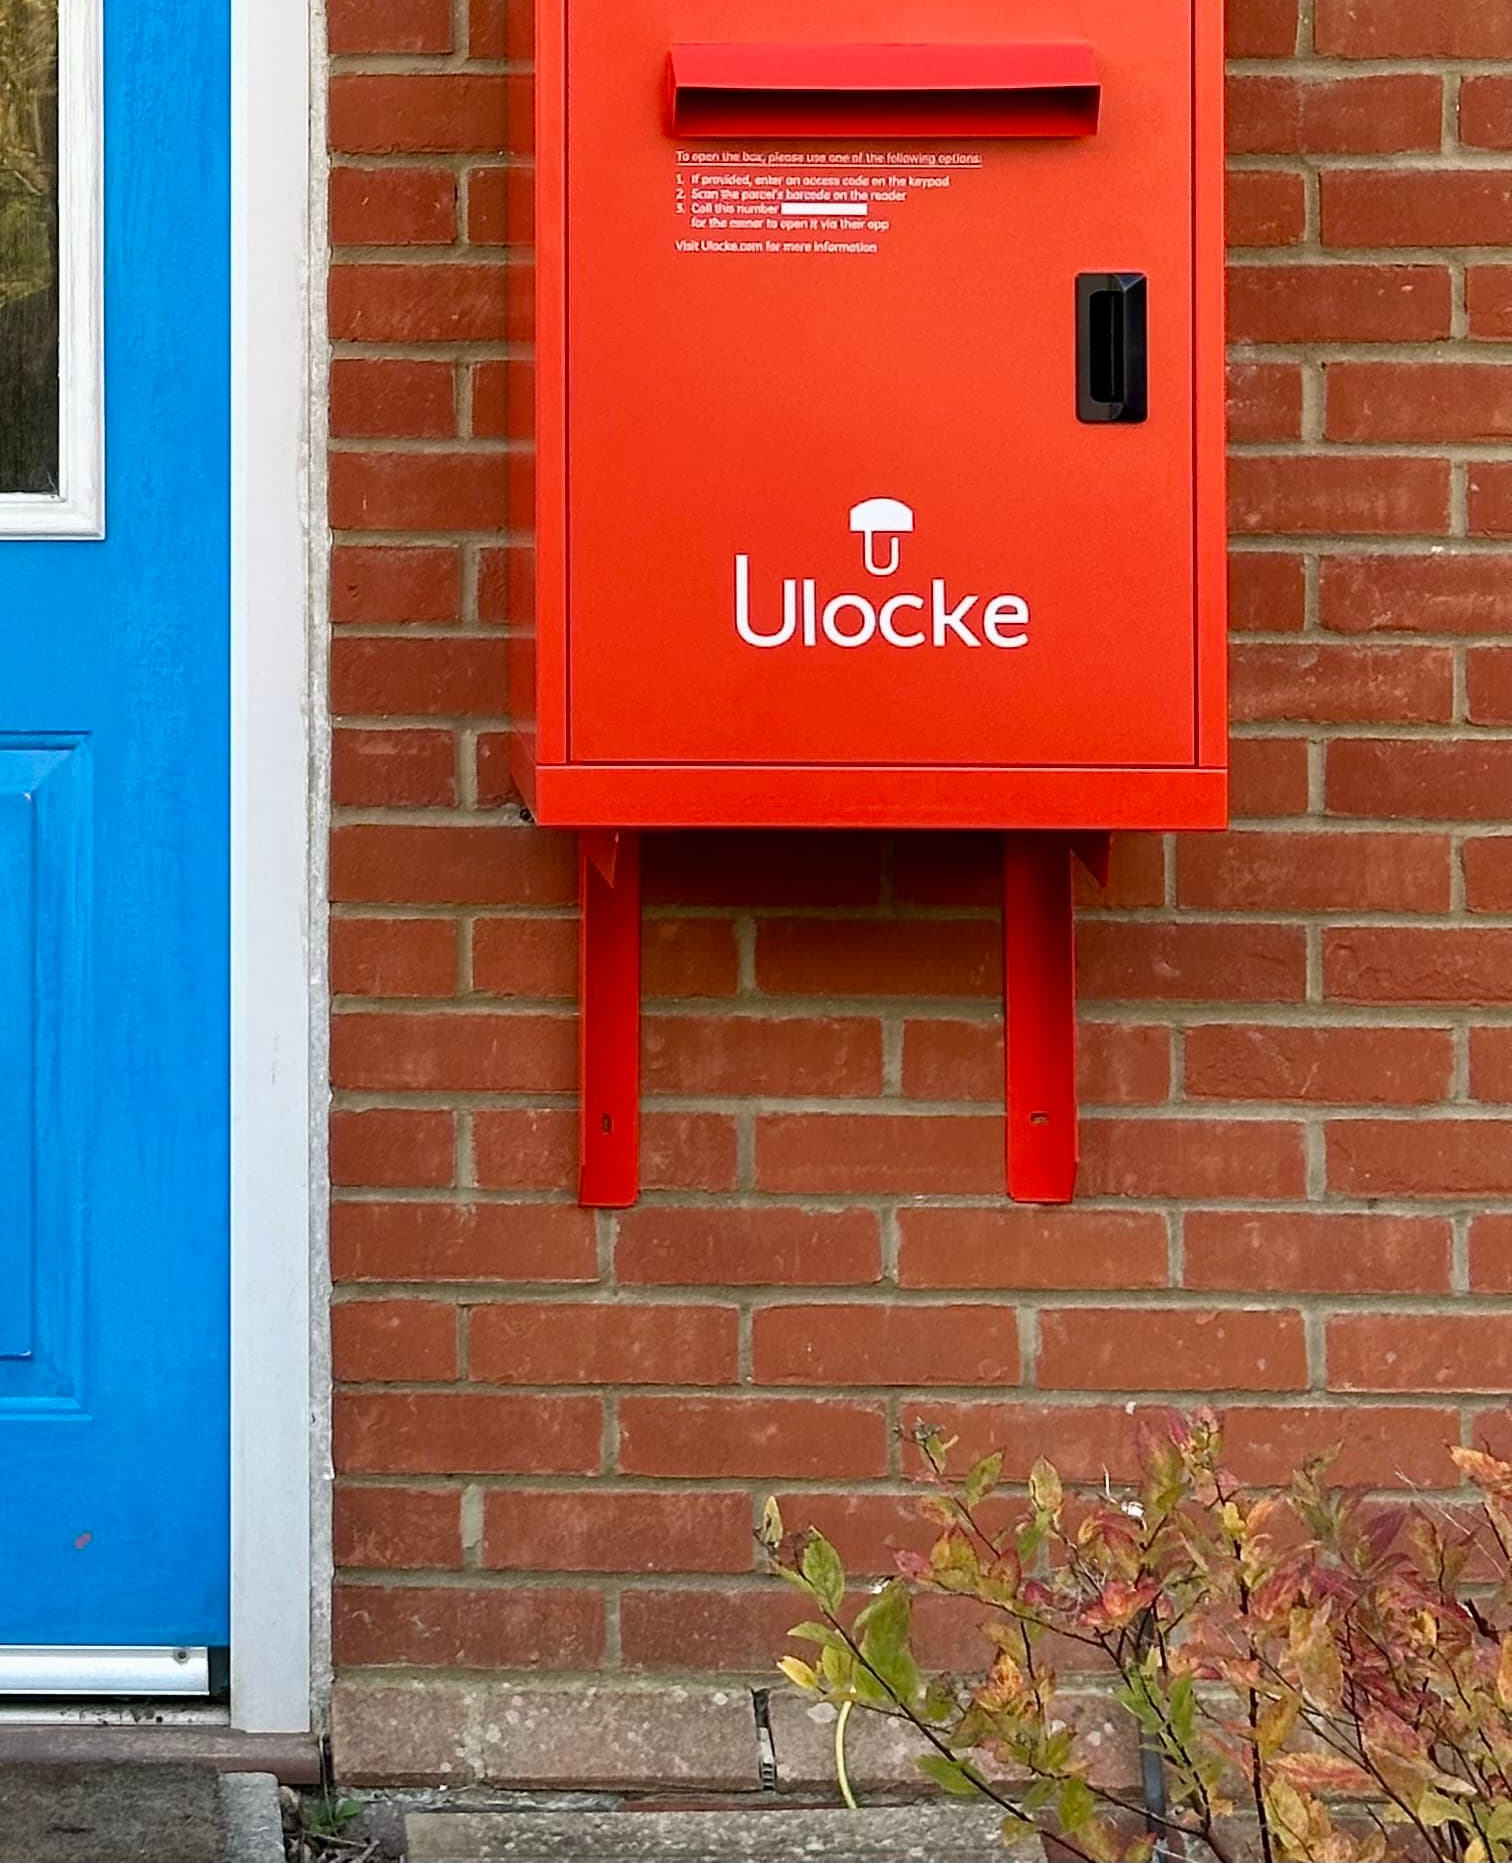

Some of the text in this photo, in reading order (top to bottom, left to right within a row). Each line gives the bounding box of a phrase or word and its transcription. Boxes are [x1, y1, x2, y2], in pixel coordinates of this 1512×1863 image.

[676, 151, 690, 162] To
[691, 153, 719, 163] open
[722, 152, 740, 162] the
[768, 152, 804, 164] please
[806, 154, 826, 163] use
[829, 154, 850, 163] one
[851, 152, 863, 163] of
[866, 153, 885, 163] the
[887, 153, 936, 165] following
[691, 174, 700, 184] If
[702, 174, 752, 186] provided,
[755, 175, 783, 185] enter
[786, 177, 800, 185] an
[803, 177, 840, 186] access
[842, 175, 869, 186] code
[871, 177, 885, 186] on
[888, 176, 906, 186] the
[908, 176, 950, 188] keypad
[691, 189, 718, 199] Scan
[720, 189, 739, 200] the
[786, 189, 831, 200] barcode
[833, 192, 847, 200] on
[850, 190, 868, 200] the
[870, 191, 907, 201] reader
[691, 203, 712, 214] Call
[714, 203, 735, 214] this
[737, 203, 779, 214] number
[691, 217, 706, 228] for
[708, 218, 727, 228] the
[766, 219, 778, 229] to
[780, 220, 808, 231] open
[810, 219, 818, 229] it
[820, 219, 838, 229] via
[867, 221, 889, 232] app
[675, 240, 699, 251] Visit
[701, 240, 763, 252] Ulocke.com
[766, 241, 781, 252] for
[814, 241, 878, 253] information
[735, 554, 1030, 648] Ulocke
